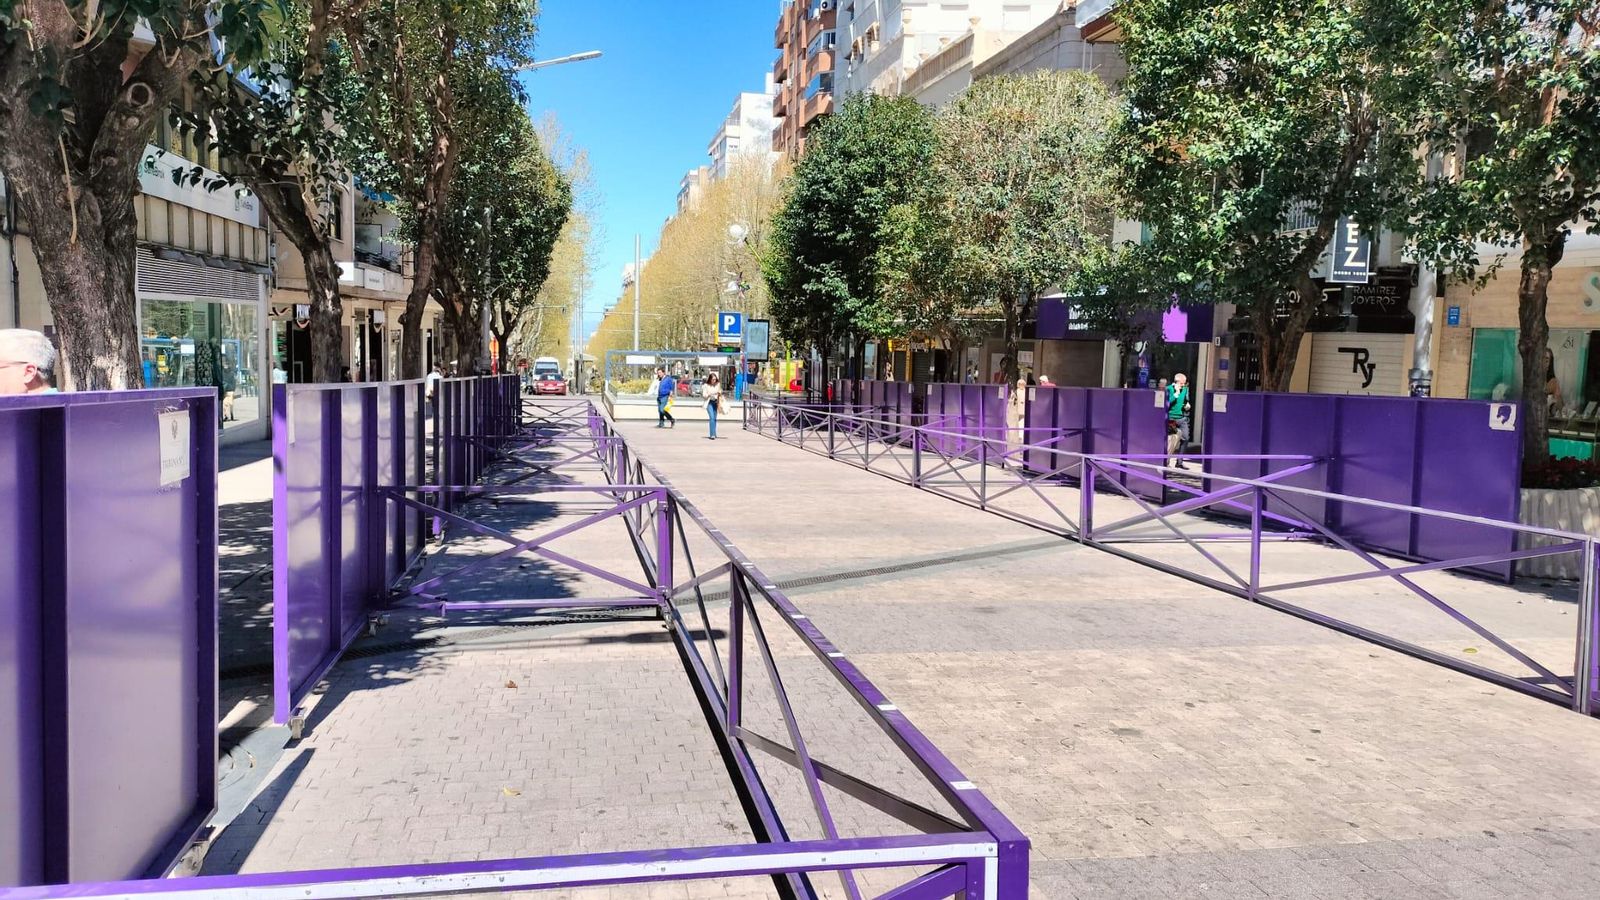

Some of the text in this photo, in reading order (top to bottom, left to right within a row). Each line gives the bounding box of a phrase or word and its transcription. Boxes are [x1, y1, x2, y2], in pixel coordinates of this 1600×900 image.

[1343, 213, 1366, 267] EZ
[1351, 296, 1401, 310] JOYEROS
[723, 315, 736, 331] P
